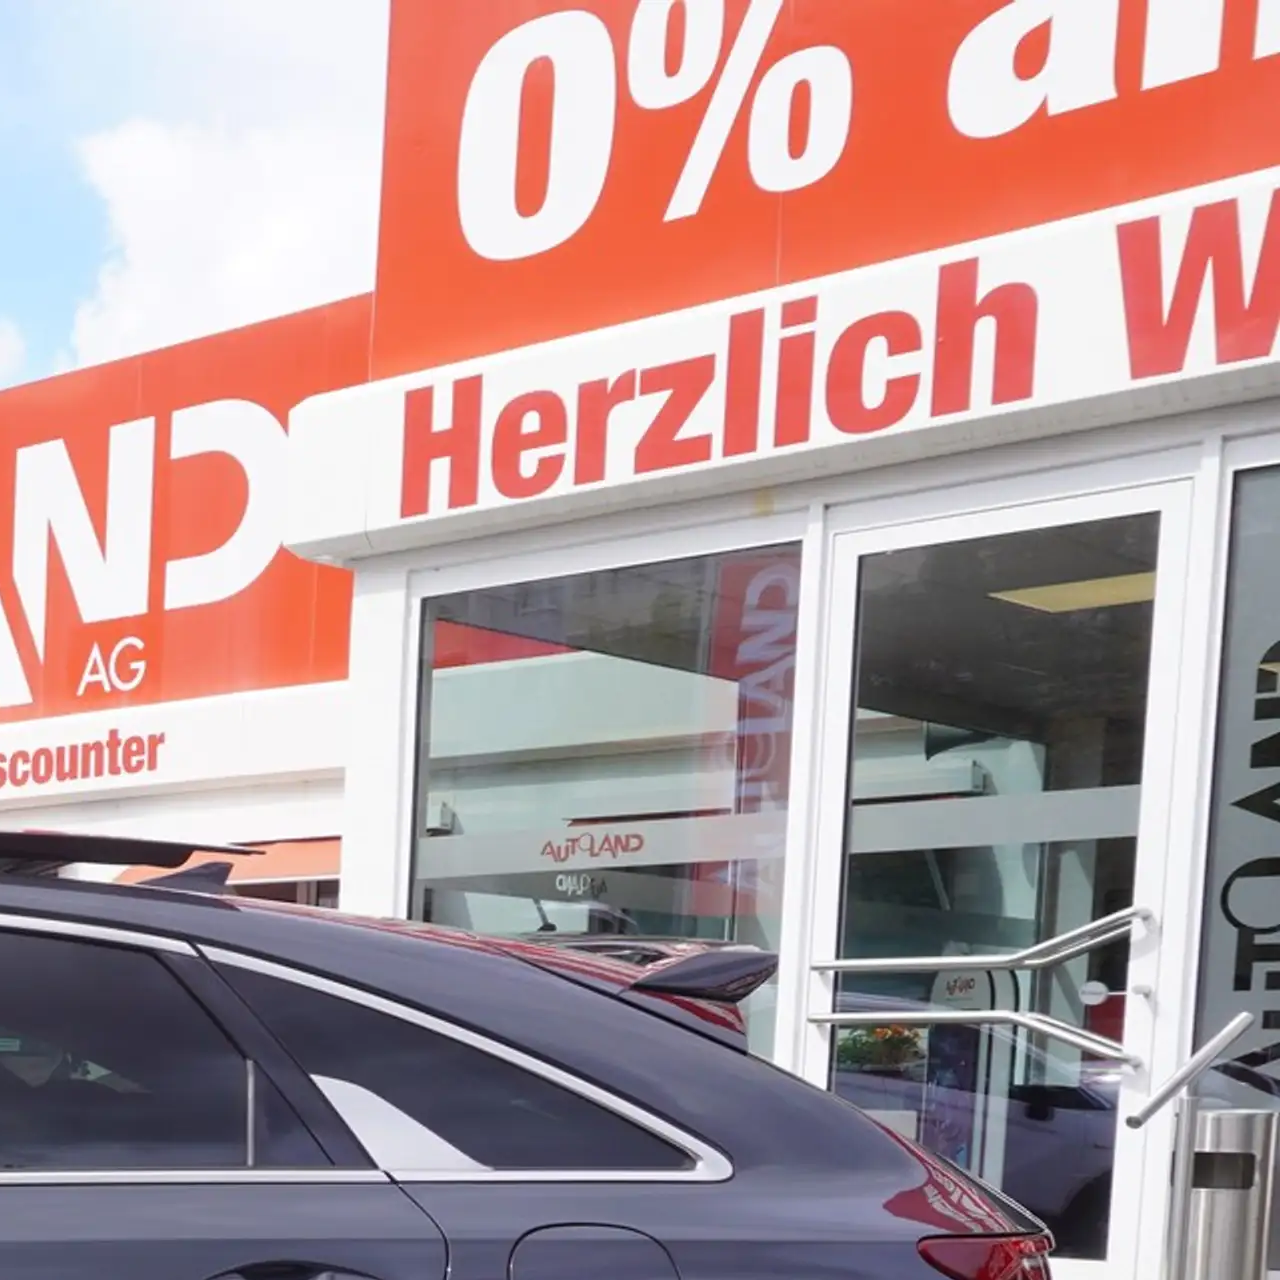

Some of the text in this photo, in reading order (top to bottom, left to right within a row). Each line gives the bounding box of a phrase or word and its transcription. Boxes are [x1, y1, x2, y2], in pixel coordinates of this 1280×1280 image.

[457, 0, 852, 261] 0%
[399, 257, 1039, 519] Herzlich
[76, 636, 148, 697] AG
[540, 832, 645, 863] AUTOLAND
